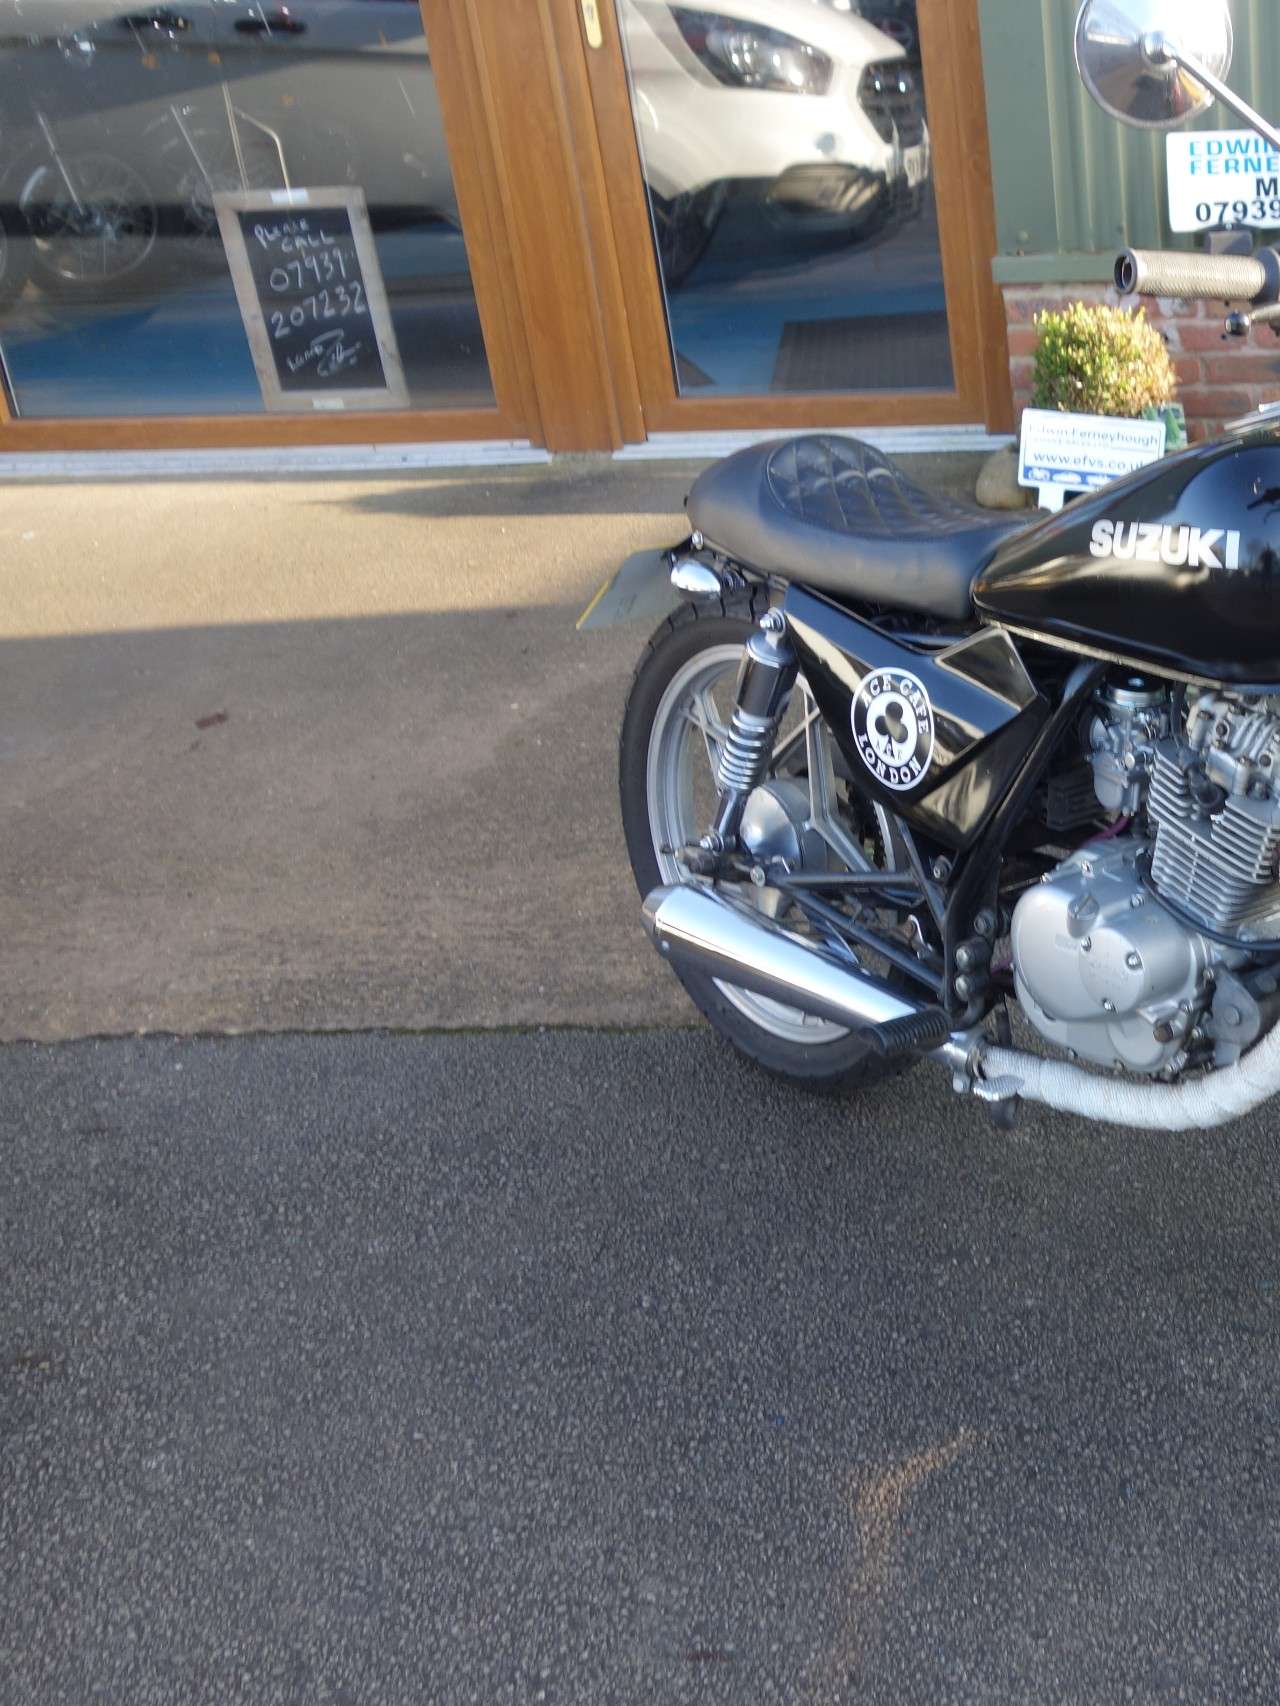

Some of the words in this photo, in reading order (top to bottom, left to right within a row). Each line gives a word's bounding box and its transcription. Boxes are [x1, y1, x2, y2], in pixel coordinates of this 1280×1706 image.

[1189, 138, 1279, 156] EDWIN
[271, 280, 366, 340] 207232
[1089, 518, 1241, 570] SUZUKI
[860, 674, 892, 709] ACE
[900, 678, 929, 734] CAFE
[858, 733, 922, 784] LONDON
